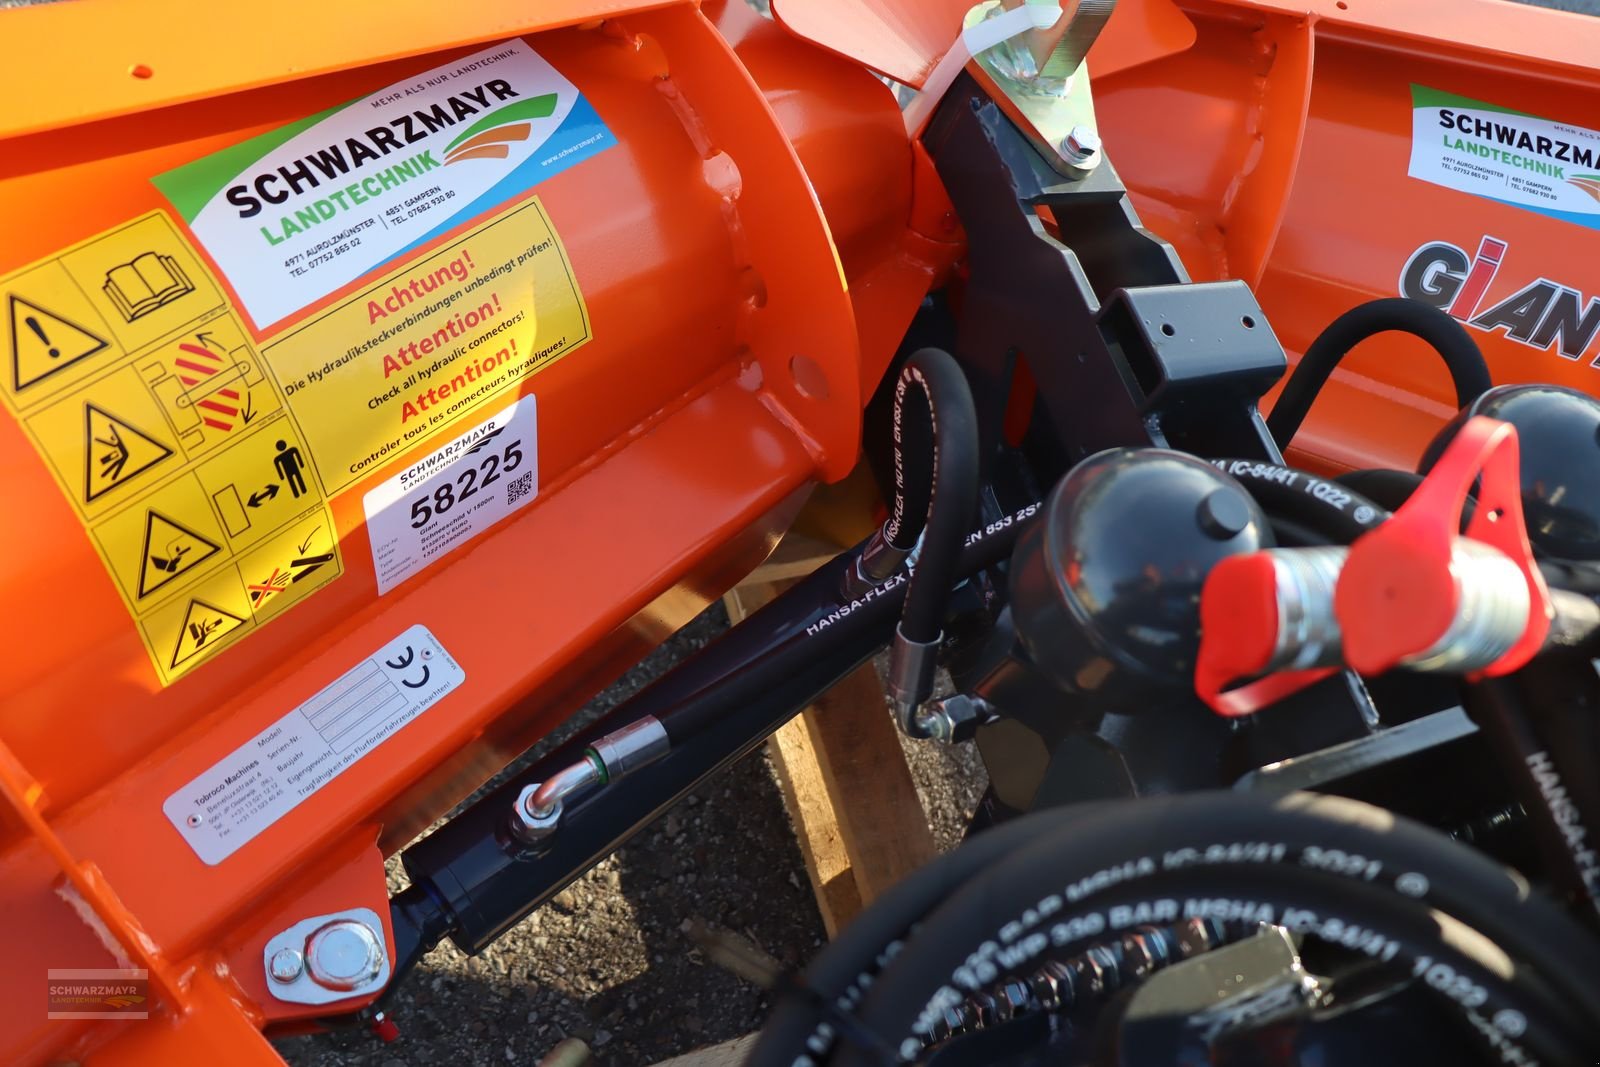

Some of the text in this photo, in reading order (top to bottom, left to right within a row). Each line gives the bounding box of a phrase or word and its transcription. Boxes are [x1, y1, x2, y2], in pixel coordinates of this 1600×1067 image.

[371, 48, 520, 109] MEHR ALS NUR LANDTECHNIK.
[226, 79, 520, 218] SCHWARZMAYR
[541, 132, 603, 167] www.schwarzmayr.at
[1553, 125, 1576, 135] MEHR
[1442, 156, 1504, 179] 4971 AUROLZMÜNSTER
[1443, 134, 1565, 180] LANDTECHNIK
[260, 149, 441, 246] LANDTECHNIK
[385, 185, 442, 217] 4851 GAMPERN
[408, 202, 431, 218] 07682
[431, 195, 446, 207] 930
[445, 190, 456, 199] 80
[1525, 179, 1553, 192] GAMPERN
[284, 217, 376, 269] 4971 AUROLZMÜNSTER
[308, 251, 335, 269] 07752
[335, 245, 350, 256] 865
[350, 237, 362, 249] 02
[367, 250, 476, 325] Achtung!
[285, 237, 554, 397] Die Hydrauliksteckverbindungen unbedingt prüfen!
[382, 292, 503, 379] Attention!
[368, 310, 526, 410] Check all hydraulic connectors!
[401, 338, 519, 424] Attention!
[349, 336, 567, 474] Contrôler tous les connecteurs hyrauliques!
[400, 421, 496, 485] SCHWARZMAYR
[402, 454, 460, 491] LANDTECHNIK
[411, 439, 523, 529] 58225
[1228, 460, 1351, 511] IC-84/41 1Q22
[420, 521, 438, 536] Giant
[421, 512, 466, 544] Schneeschild
[985, 516, 1013, 537] 853
[806, 569, 907, 636] HANSA-FLEX
[257, 727, 282, 748] Modell
[267, 735, 303, 760] Serien-Nr.
[297, 680, 452, 797] Tragfähigkeit des Flurförderfahrzeuges beachten!
[193, 759, 260, 807] Tobroco Machines
[276, 751, 304, 773] Baujahr
[287, 750, 333, 785] Eigengewicht
[206, 775, 257, 815] Beneluxstraat
[1108, 899, 1179, 930] BAR
[1183, 898, 1275, 924] MSHA
